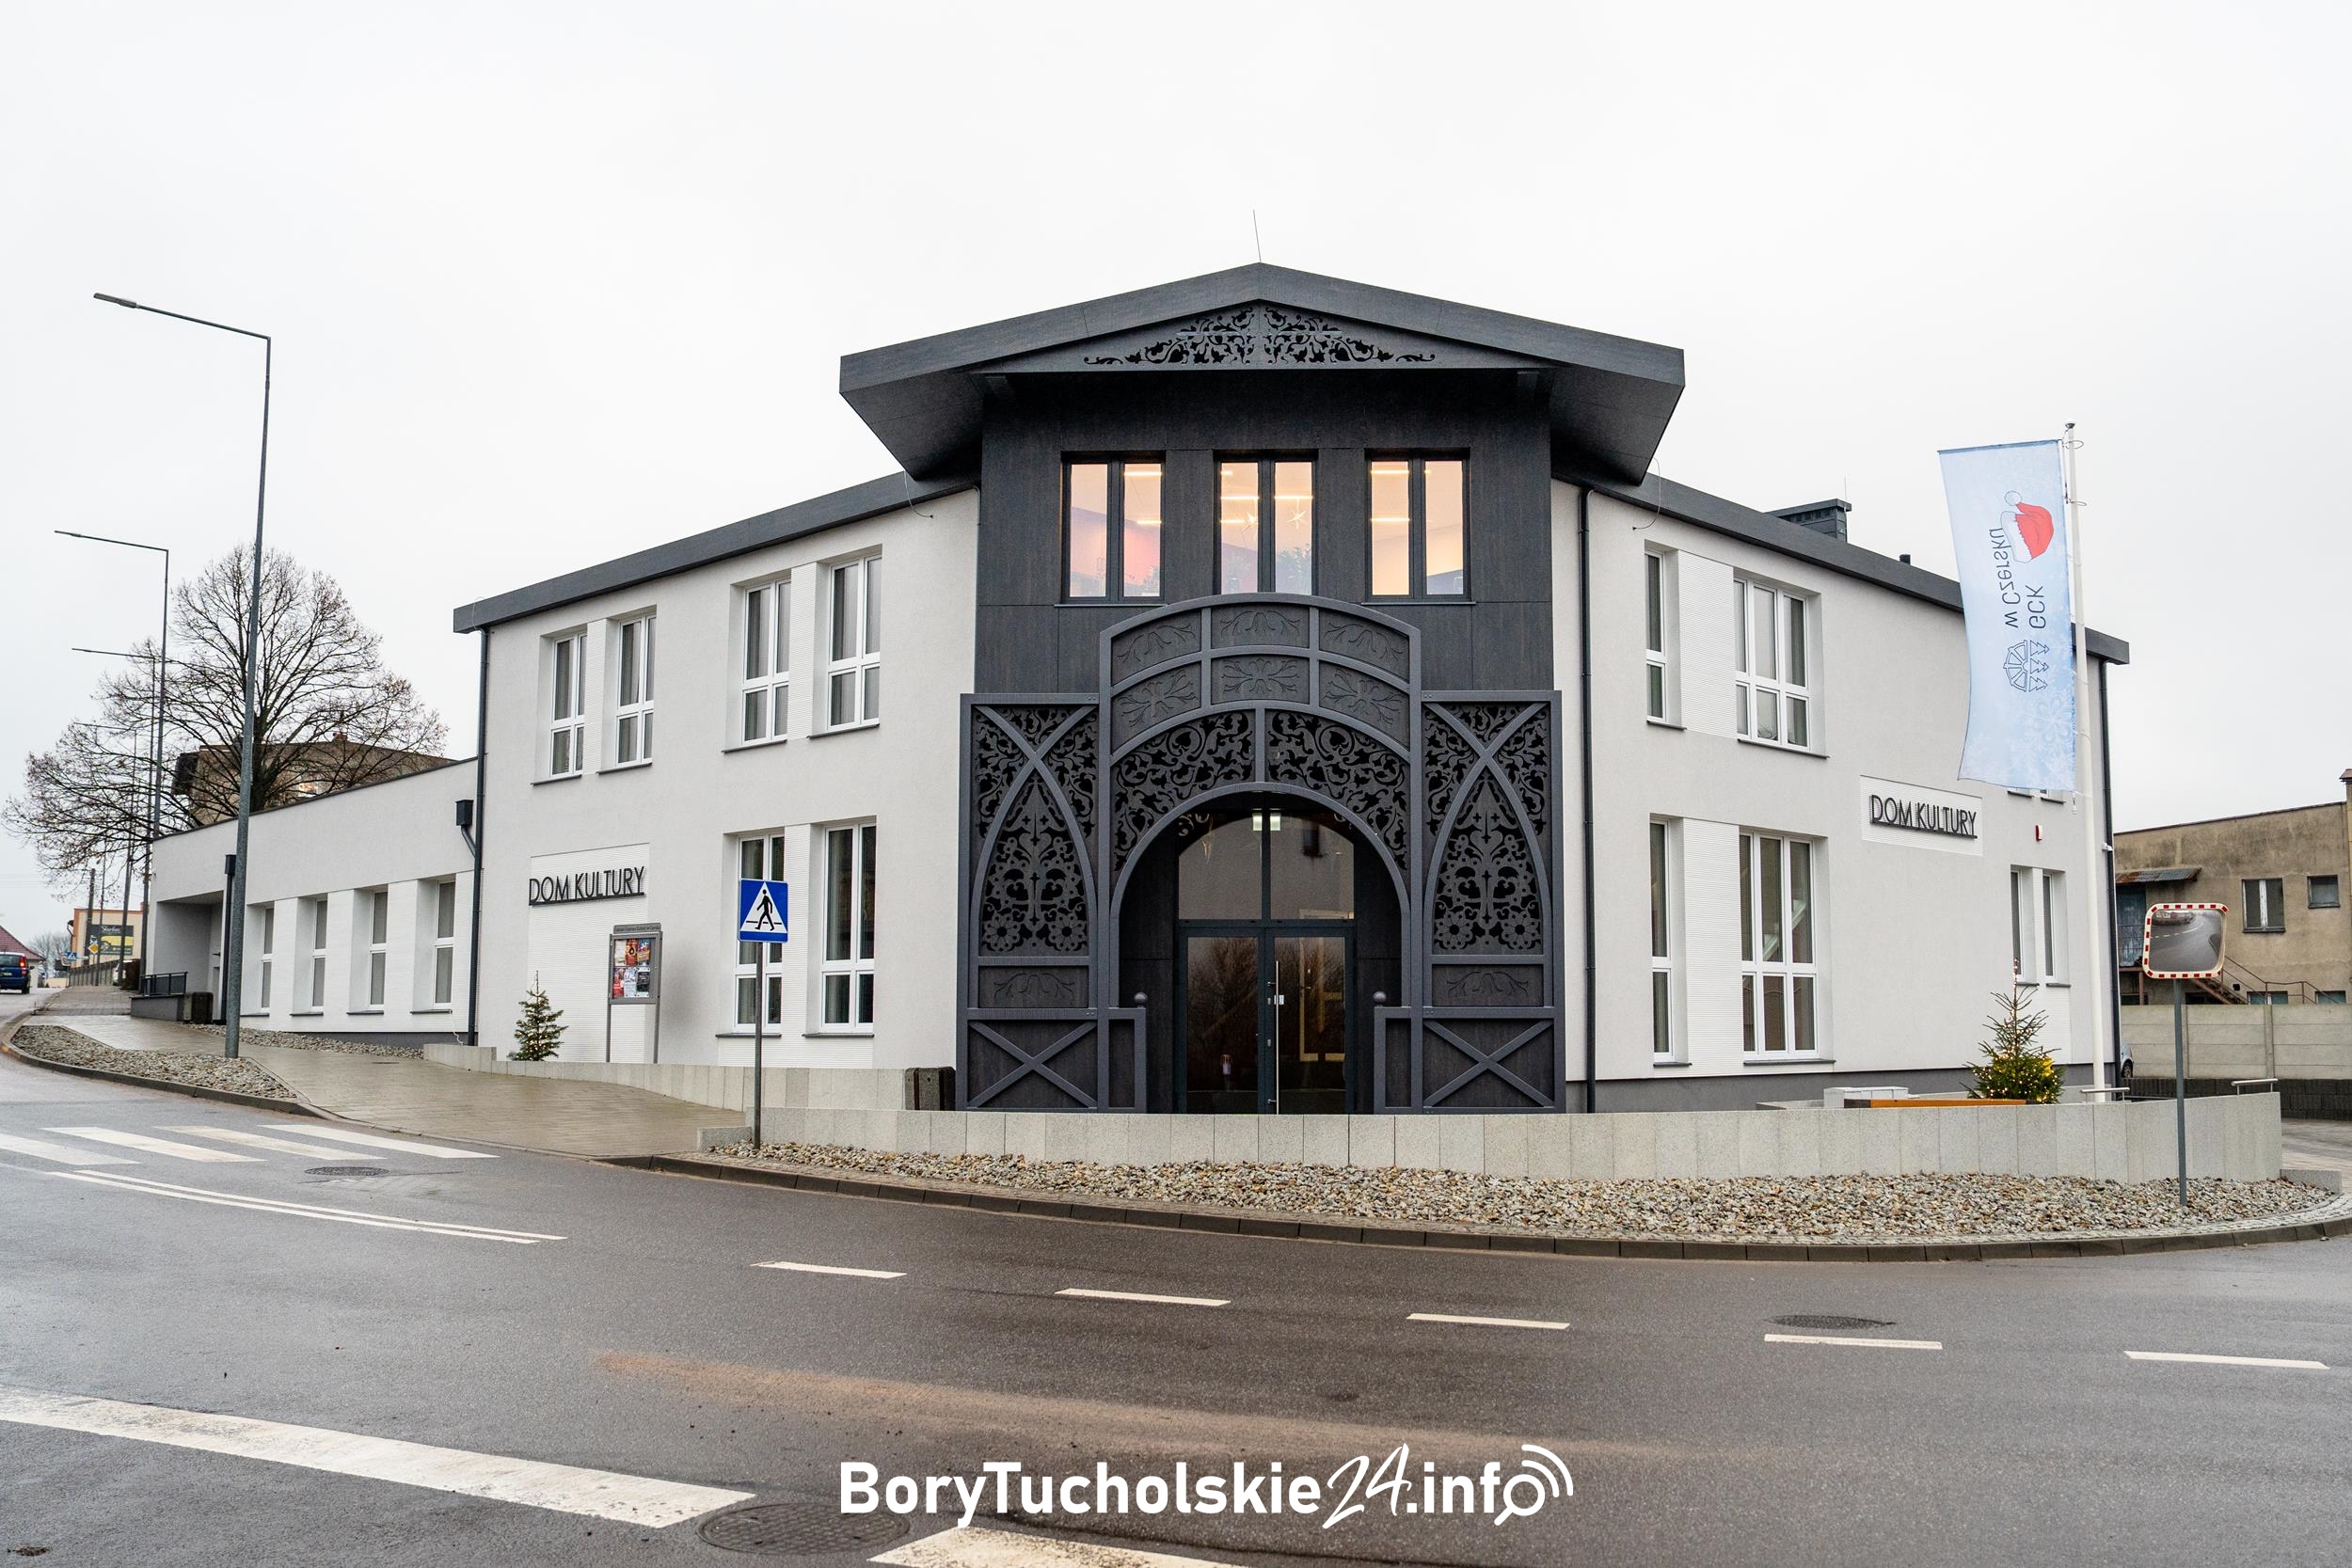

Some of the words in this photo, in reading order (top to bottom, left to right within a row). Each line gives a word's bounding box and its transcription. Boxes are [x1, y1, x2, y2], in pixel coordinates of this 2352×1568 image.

[1871, 794, 1913, 827] DOM
[1917, 801, 1977, 837] KULTURY
[529, 874, 569, 903] DOM
[575, 866, 644, 900] KULTURY
